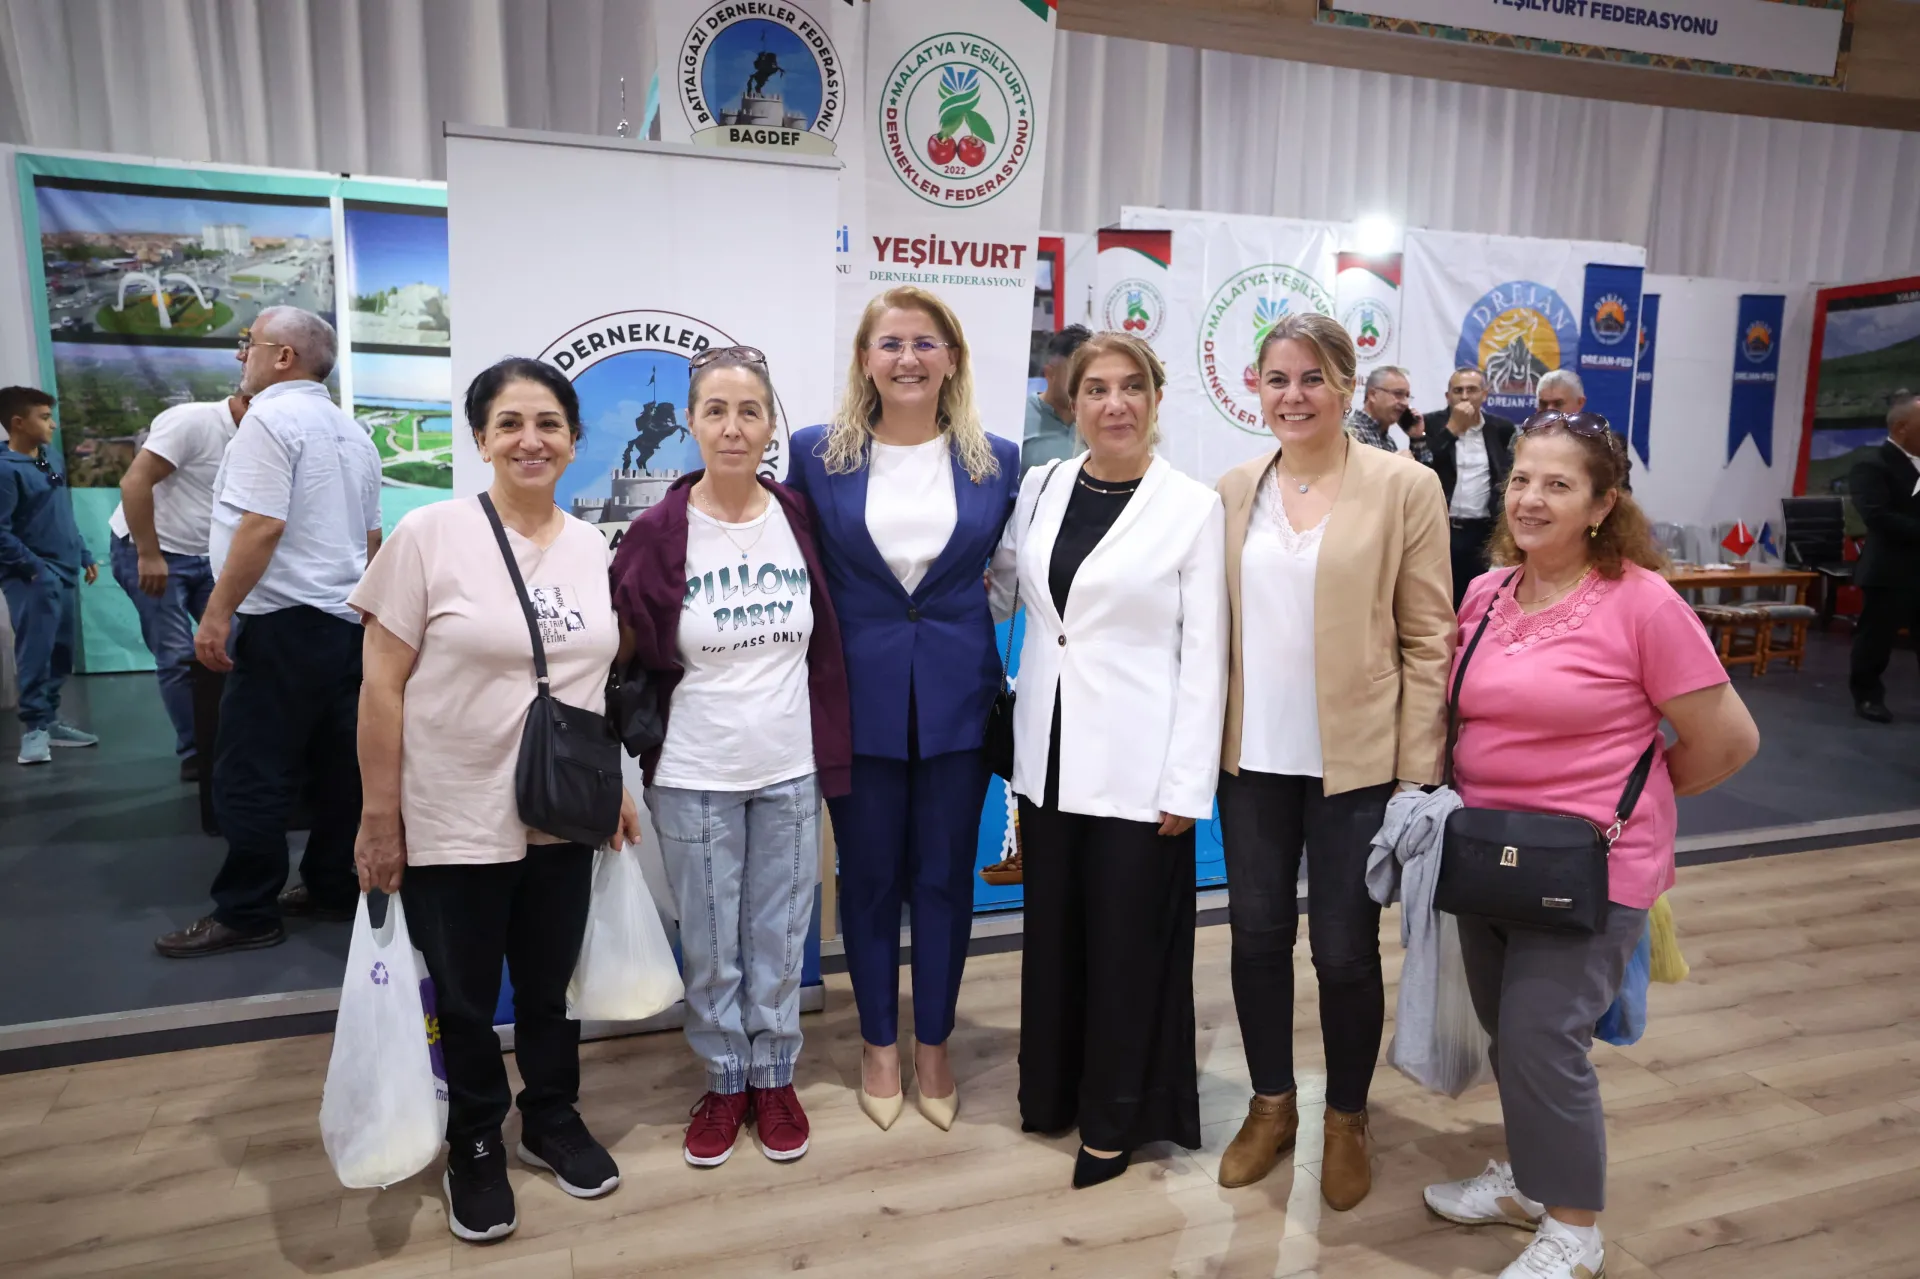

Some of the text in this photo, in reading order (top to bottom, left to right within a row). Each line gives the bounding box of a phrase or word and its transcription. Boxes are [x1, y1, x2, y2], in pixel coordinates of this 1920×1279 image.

[1591, 3, 1718, 36] FEDERASYONU
[684, 2, 839, 133] BATTALGAZİ DERNEKLER FEDERASYONU
[890, 41, 1027, 106] MALATYA YEŞİLYURT
[729, 128, 800, 146] BAGDEF
[886, 107, 1029, 201] DERNEKLER FEDERASYONU
[944, 165, 966, 175] 2022
[872, 233, 1027, 269] YEŞİLYURT
[869, 270, 1026, 288] DERNEKLER FEDERASYONU
[1207, 272, 1269, 331] MALATYA
[1272, 272, 1331, 316] YEŞİLYU
[553, 324, 710, 372] DERNEKLER
[1204, 340, 1257, 427] DERNEKLER
[553, 586, 566, 608] PARK
[682, 563, 807, 610] PILLOW
[538, 620, 564, 629] HE TRIP
[713, 600, 793, 632] PARTY
[542, 634, 567, 643] FETIME
[702, 631, 803, 653] VIP PASS ONLY
